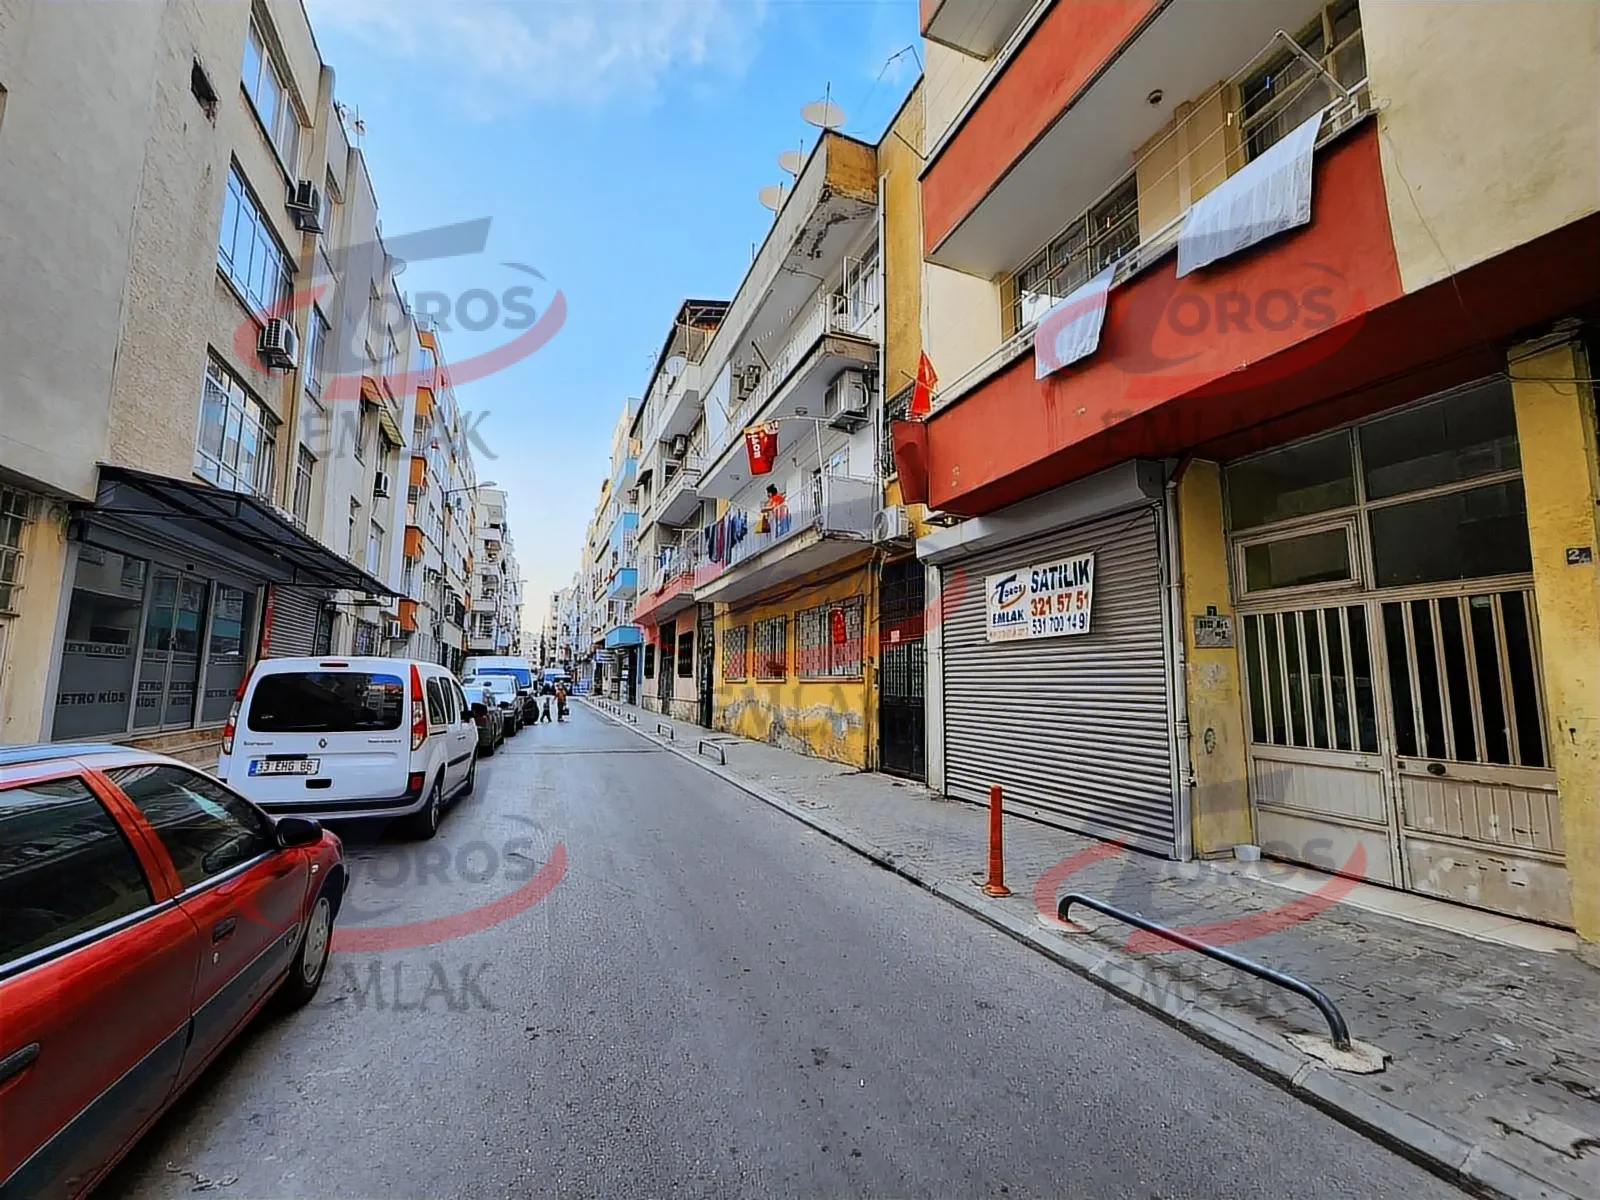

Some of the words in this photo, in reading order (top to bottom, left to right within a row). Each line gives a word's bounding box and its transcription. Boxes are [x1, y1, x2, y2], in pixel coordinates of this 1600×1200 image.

[1031, 559, 1090, 593] SATILIK
[1031, 595, 1052, 616] 321
[1057, 592, 1072, 612] 57
[1077, 590, 1089, 609] 51
[993, 609, 1024, 625] EMLAK
